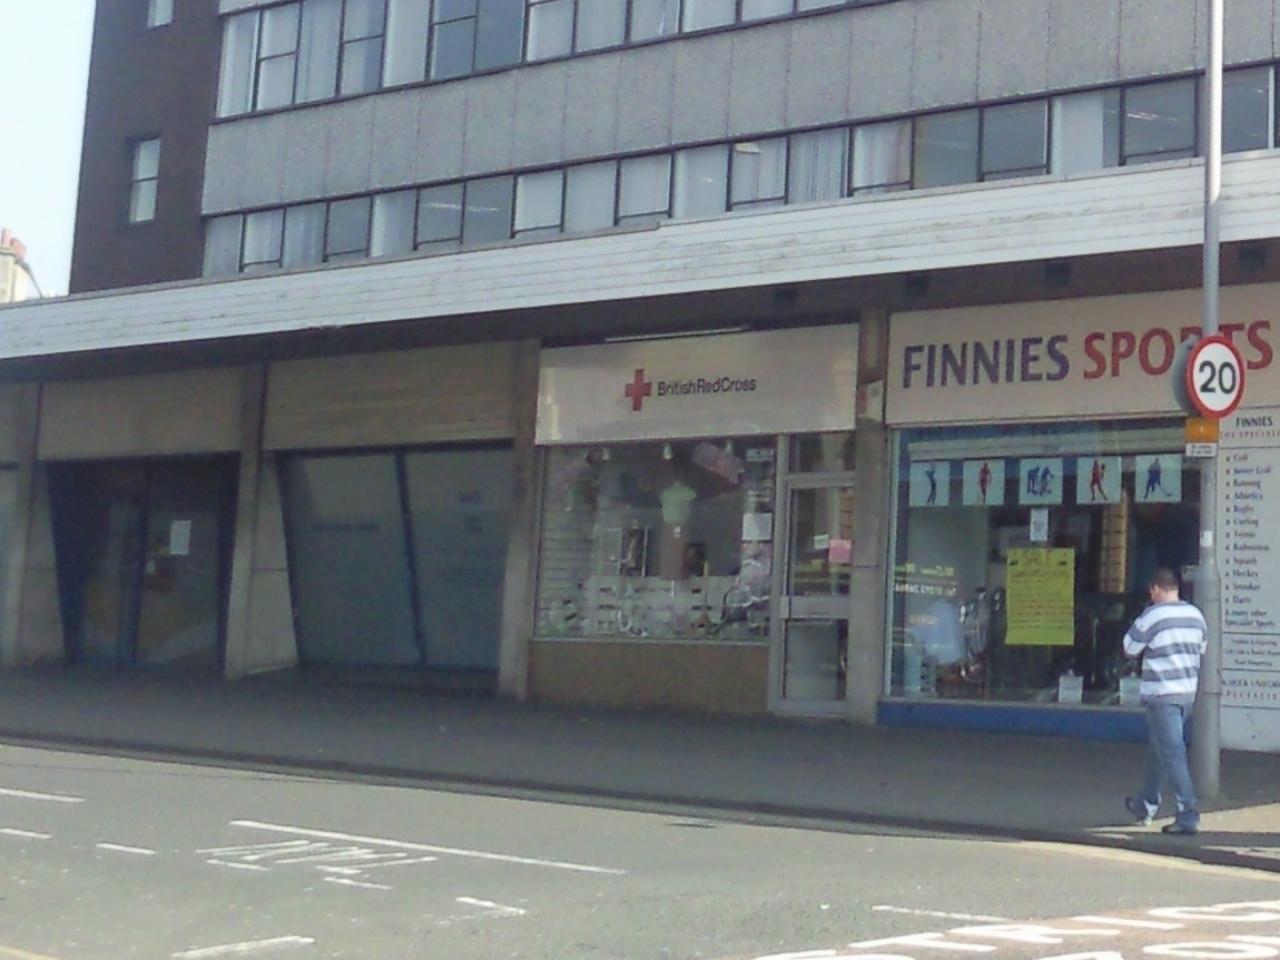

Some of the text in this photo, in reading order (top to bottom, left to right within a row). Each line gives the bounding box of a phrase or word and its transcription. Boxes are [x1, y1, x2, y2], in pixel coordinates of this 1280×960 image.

[903, 320, 1274, 389] FINNIES SPOTS
[1199, 360, 1237, 394] 20
[1236, 416, 1273, 428] FINNIES
